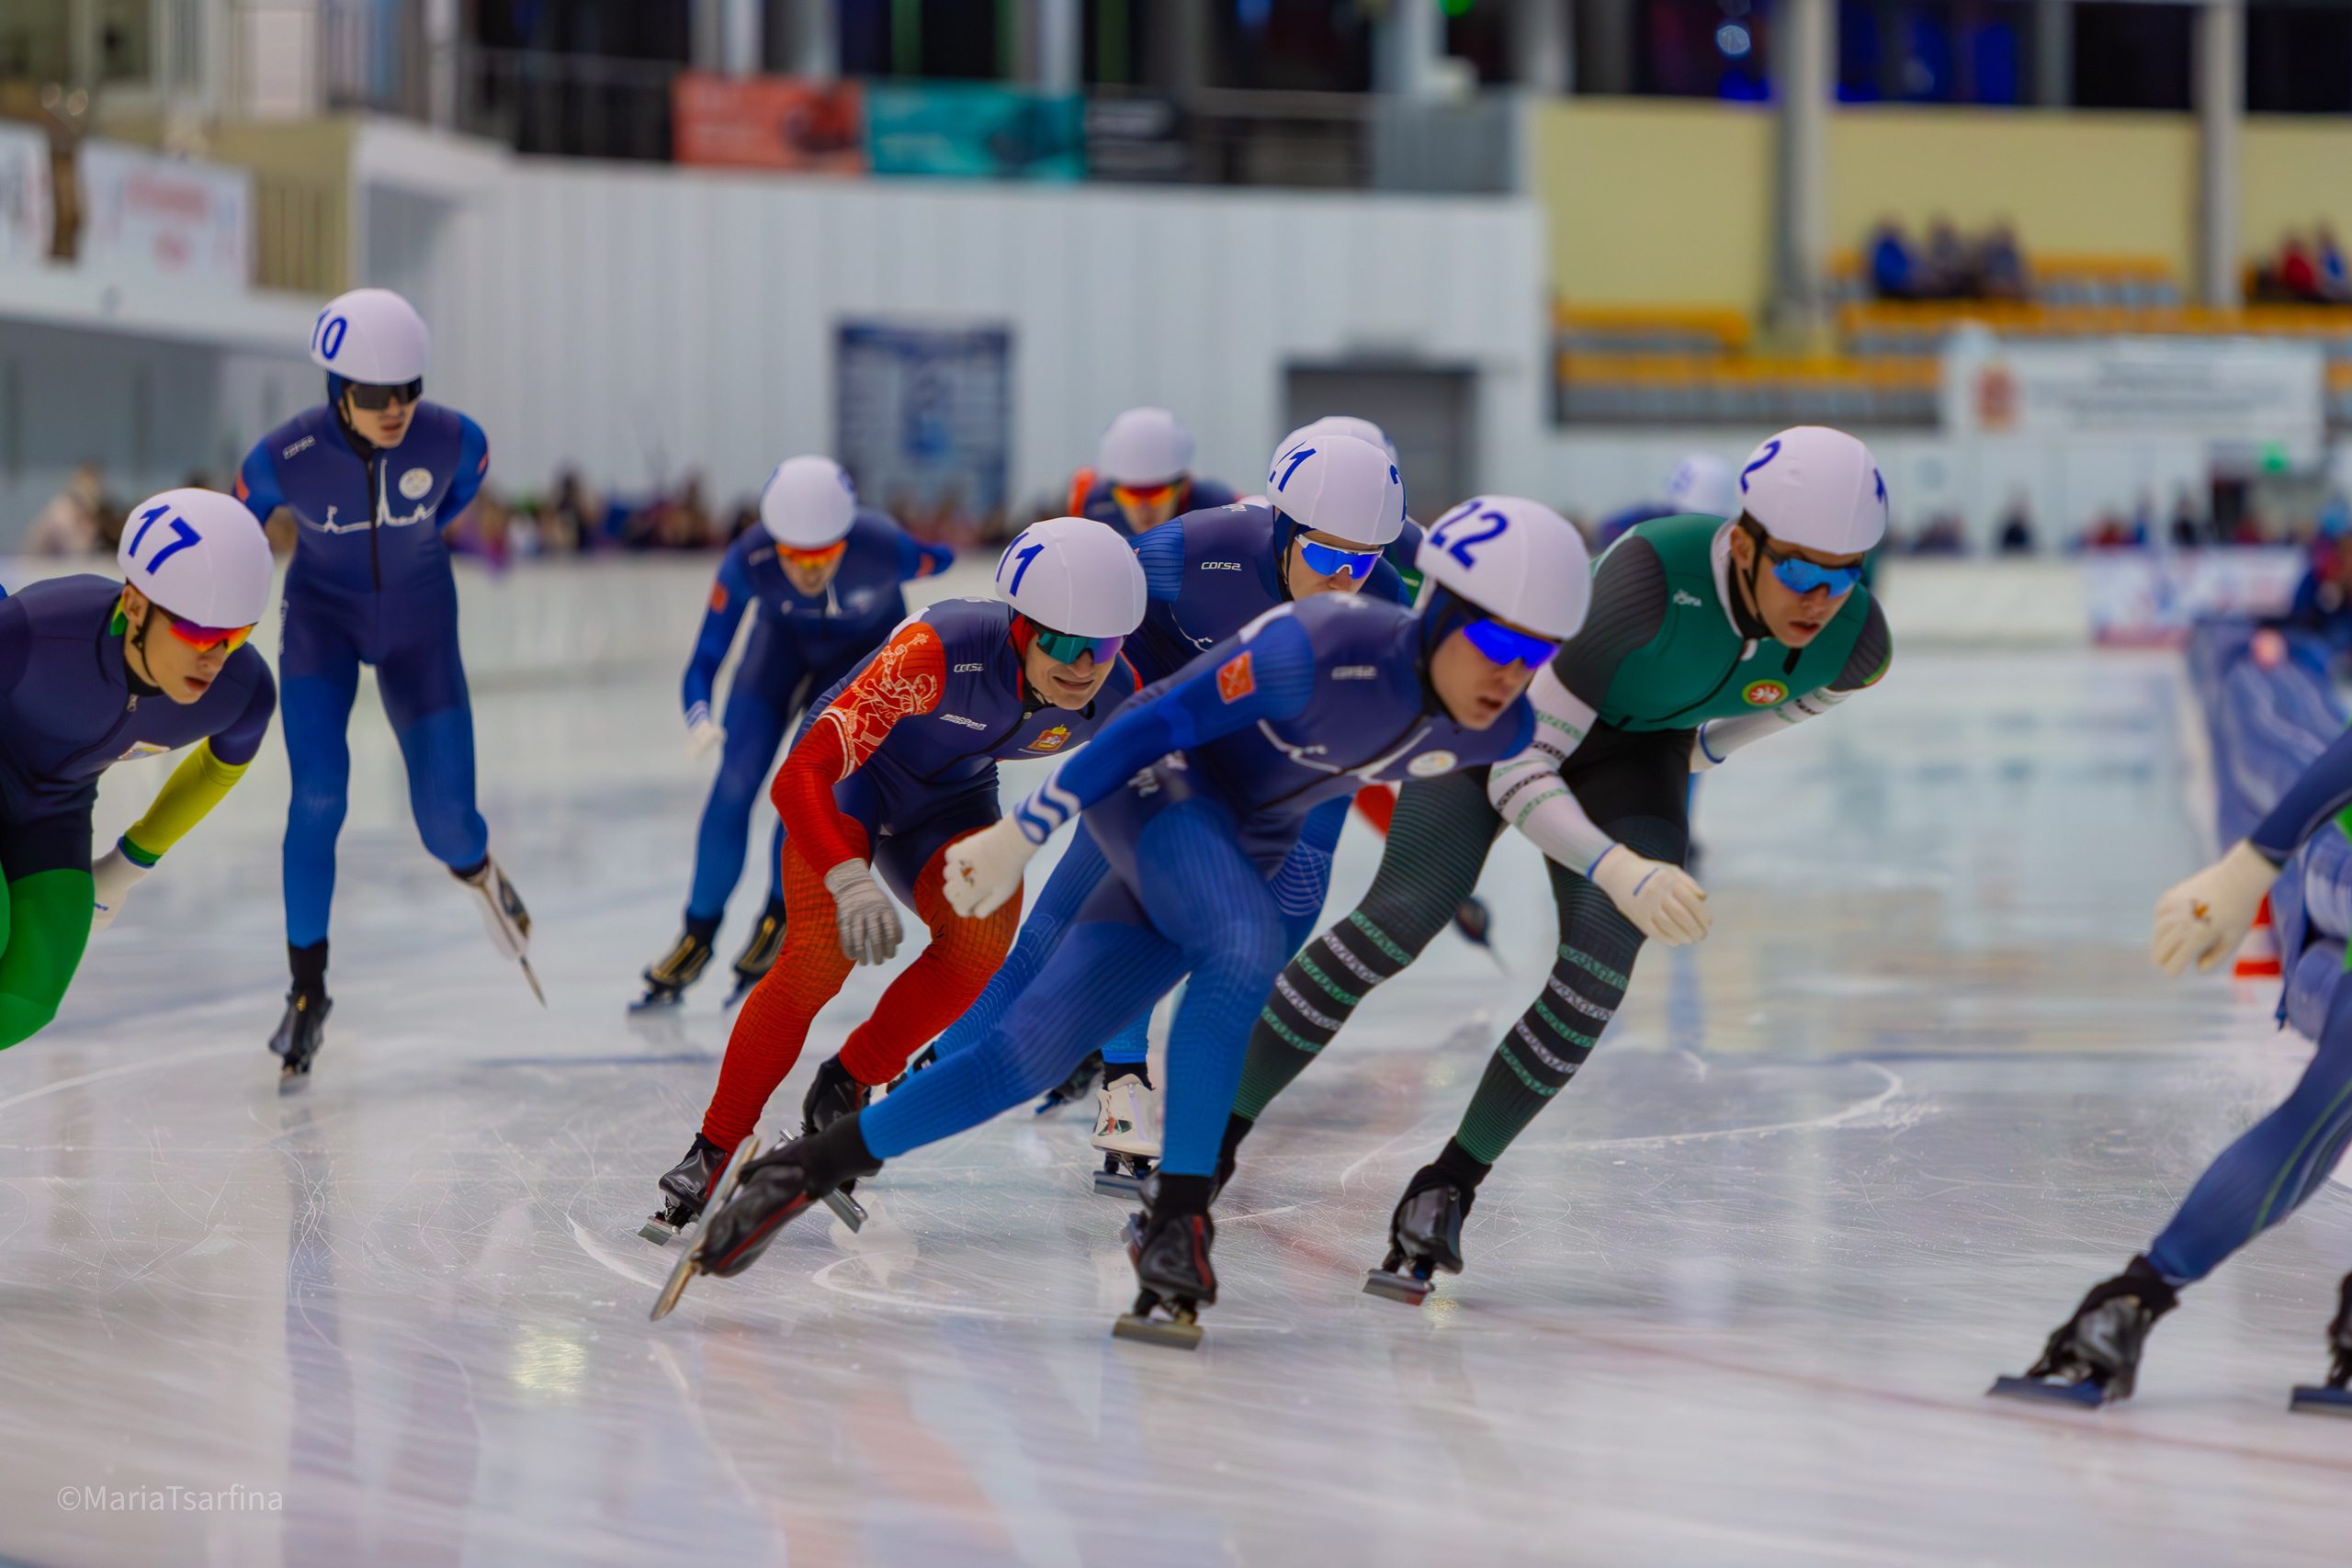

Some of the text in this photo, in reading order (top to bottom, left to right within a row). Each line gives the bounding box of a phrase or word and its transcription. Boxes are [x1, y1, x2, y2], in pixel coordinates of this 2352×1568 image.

[311, 308, 347, 360] 10
[128, 504, 202, 575] 17
[1201, 561, 1242, 570] corsa
[1430, 500, 1509, 572] 22
